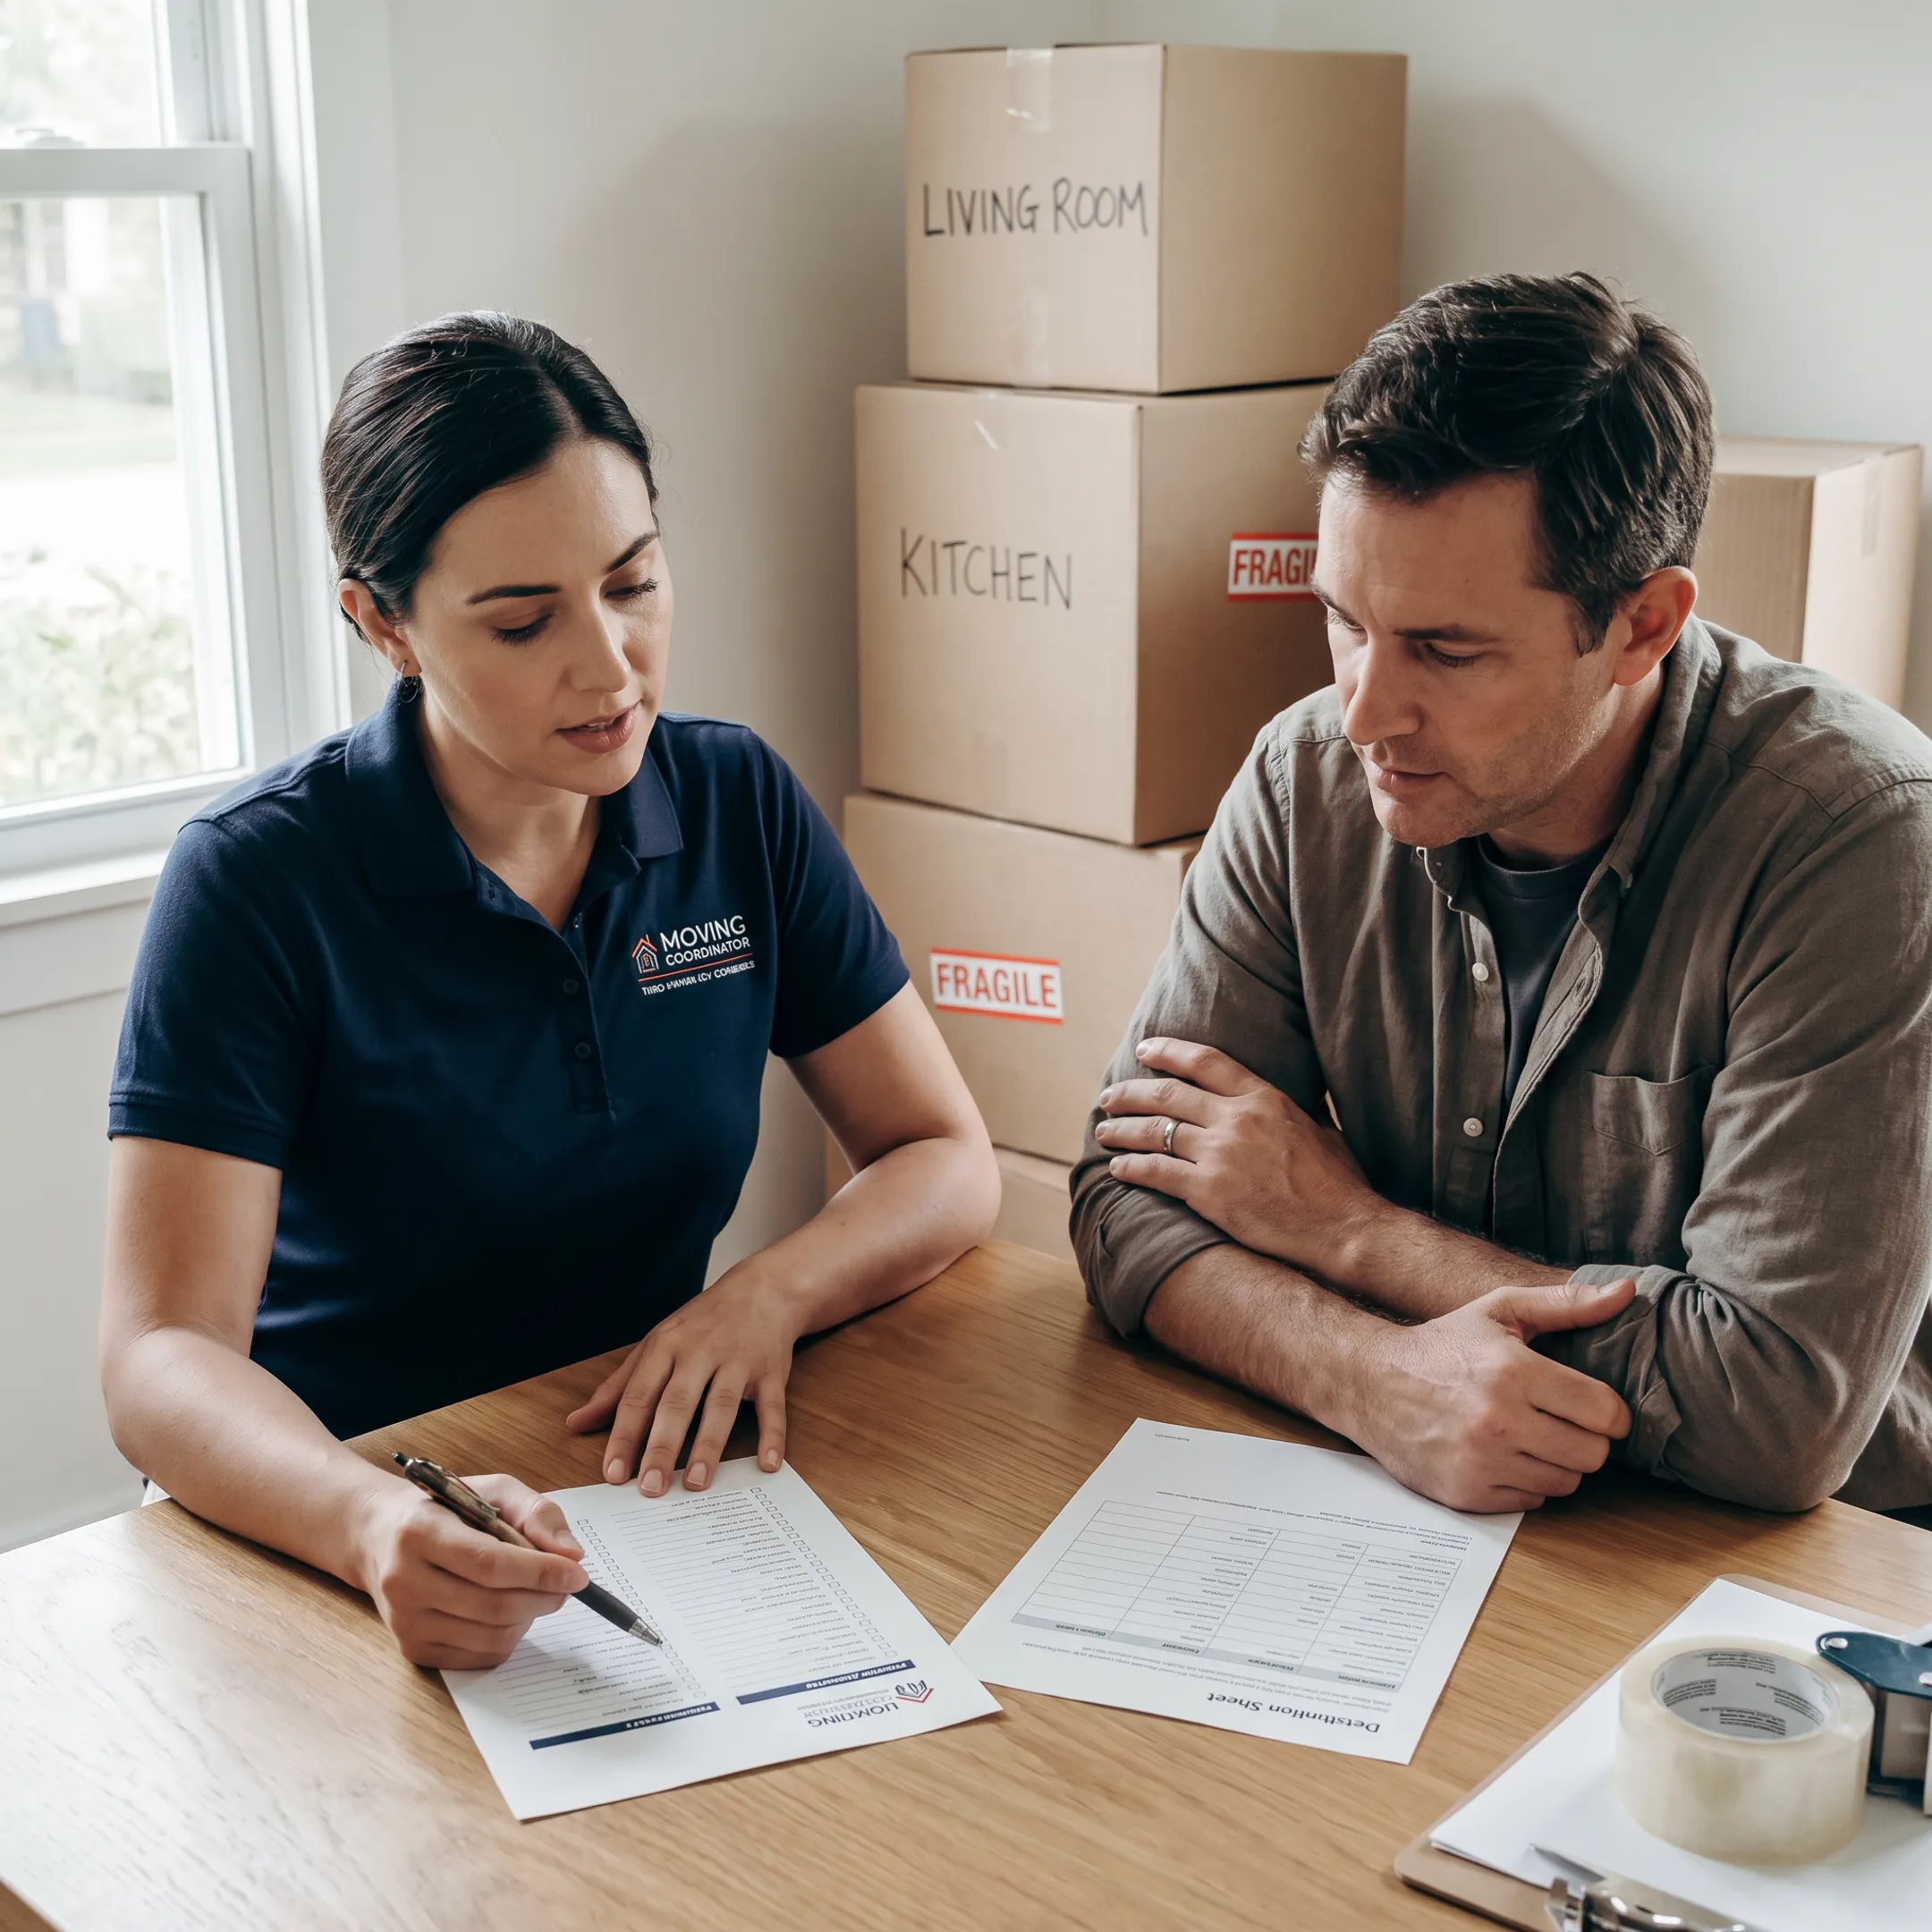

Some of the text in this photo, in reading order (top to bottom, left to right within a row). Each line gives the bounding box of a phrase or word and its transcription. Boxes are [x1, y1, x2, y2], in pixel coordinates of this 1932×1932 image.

[923, 176, 1148, 237] LIVING ROOM
[901, 527, 1071, 610] KITCHEN
[1233, 547, 1318, 586] FRAGI
[659, 915, 746, 953] MOVING
[665, 936, 750, 966] COORDINATOR
[936, 963, 1057, 1009] FRAGILE
[1206, 1692, 1263, 1712] Sheet
